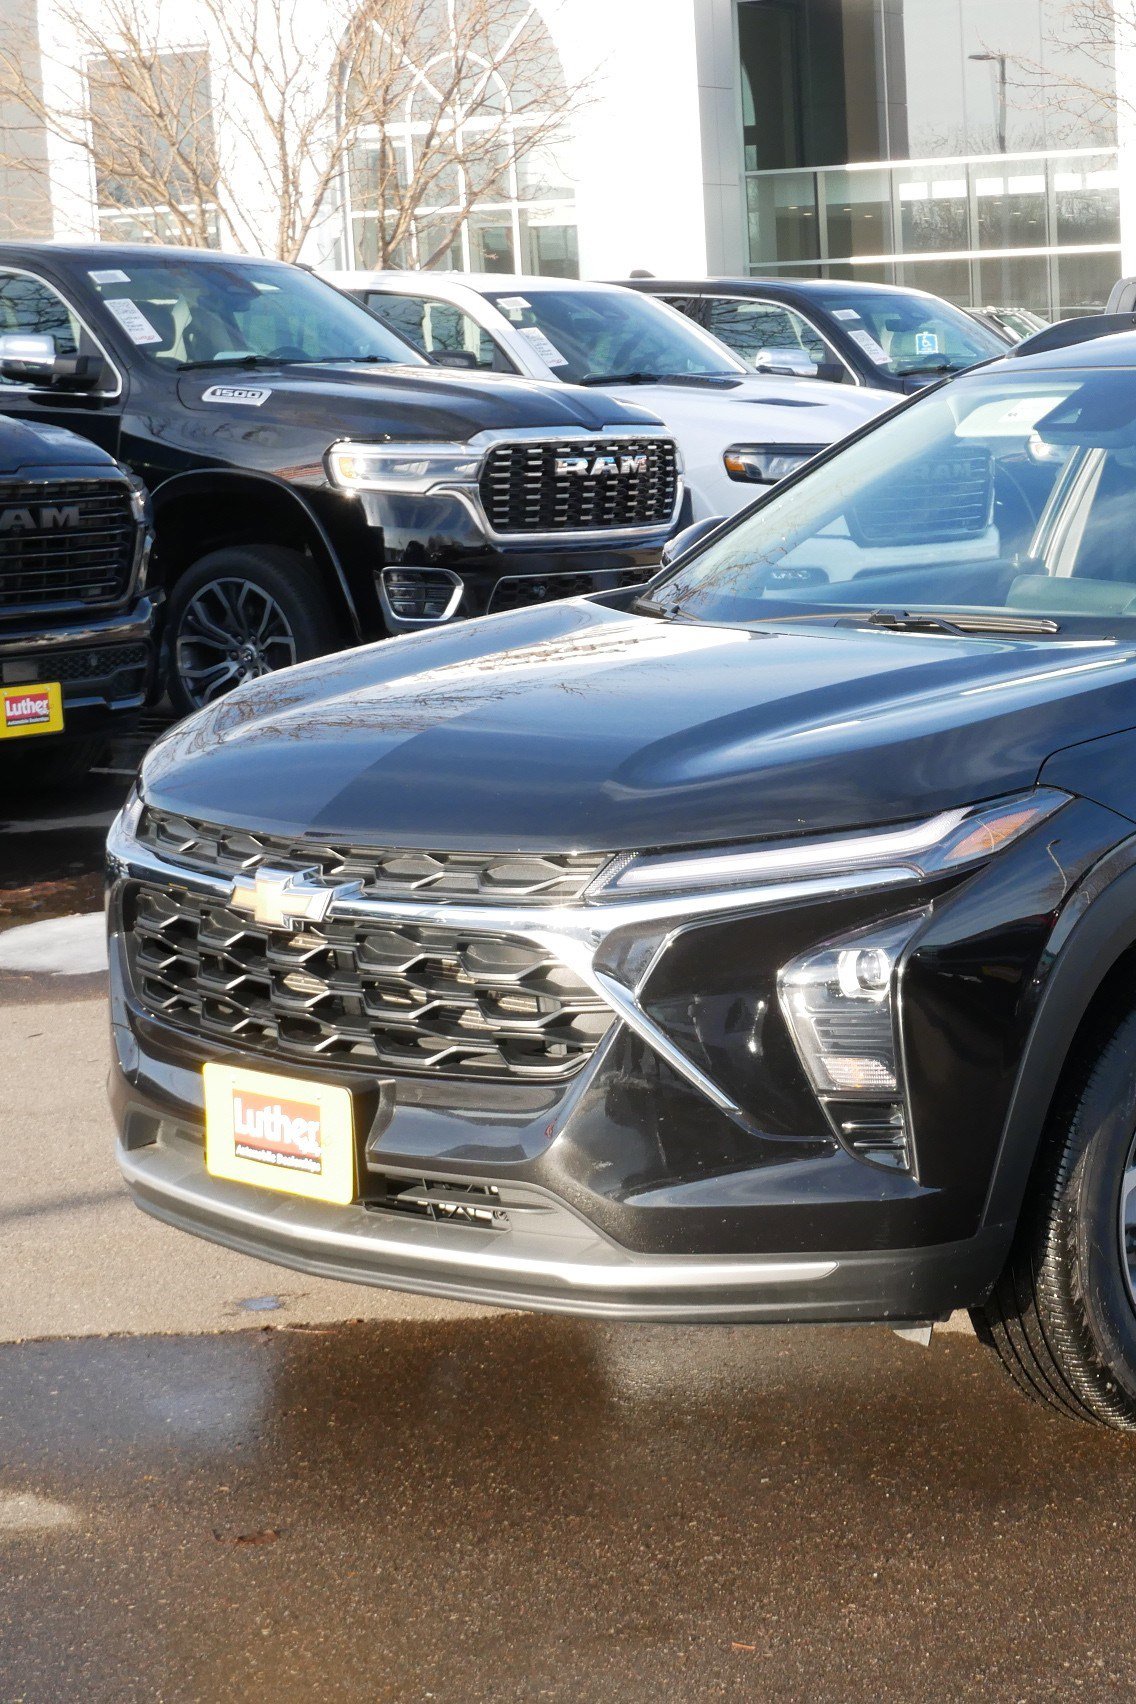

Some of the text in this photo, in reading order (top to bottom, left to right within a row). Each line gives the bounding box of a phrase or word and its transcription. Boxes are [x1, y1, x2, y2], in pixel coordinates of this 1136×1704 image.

[214, 387, 262, 399] 1500
[555, 455, 647, 476] RAM
[0, 506, 80, 530] AM
[5, 697, 49, 716] Luther
[233, 1097, 321, 1148] Luther
